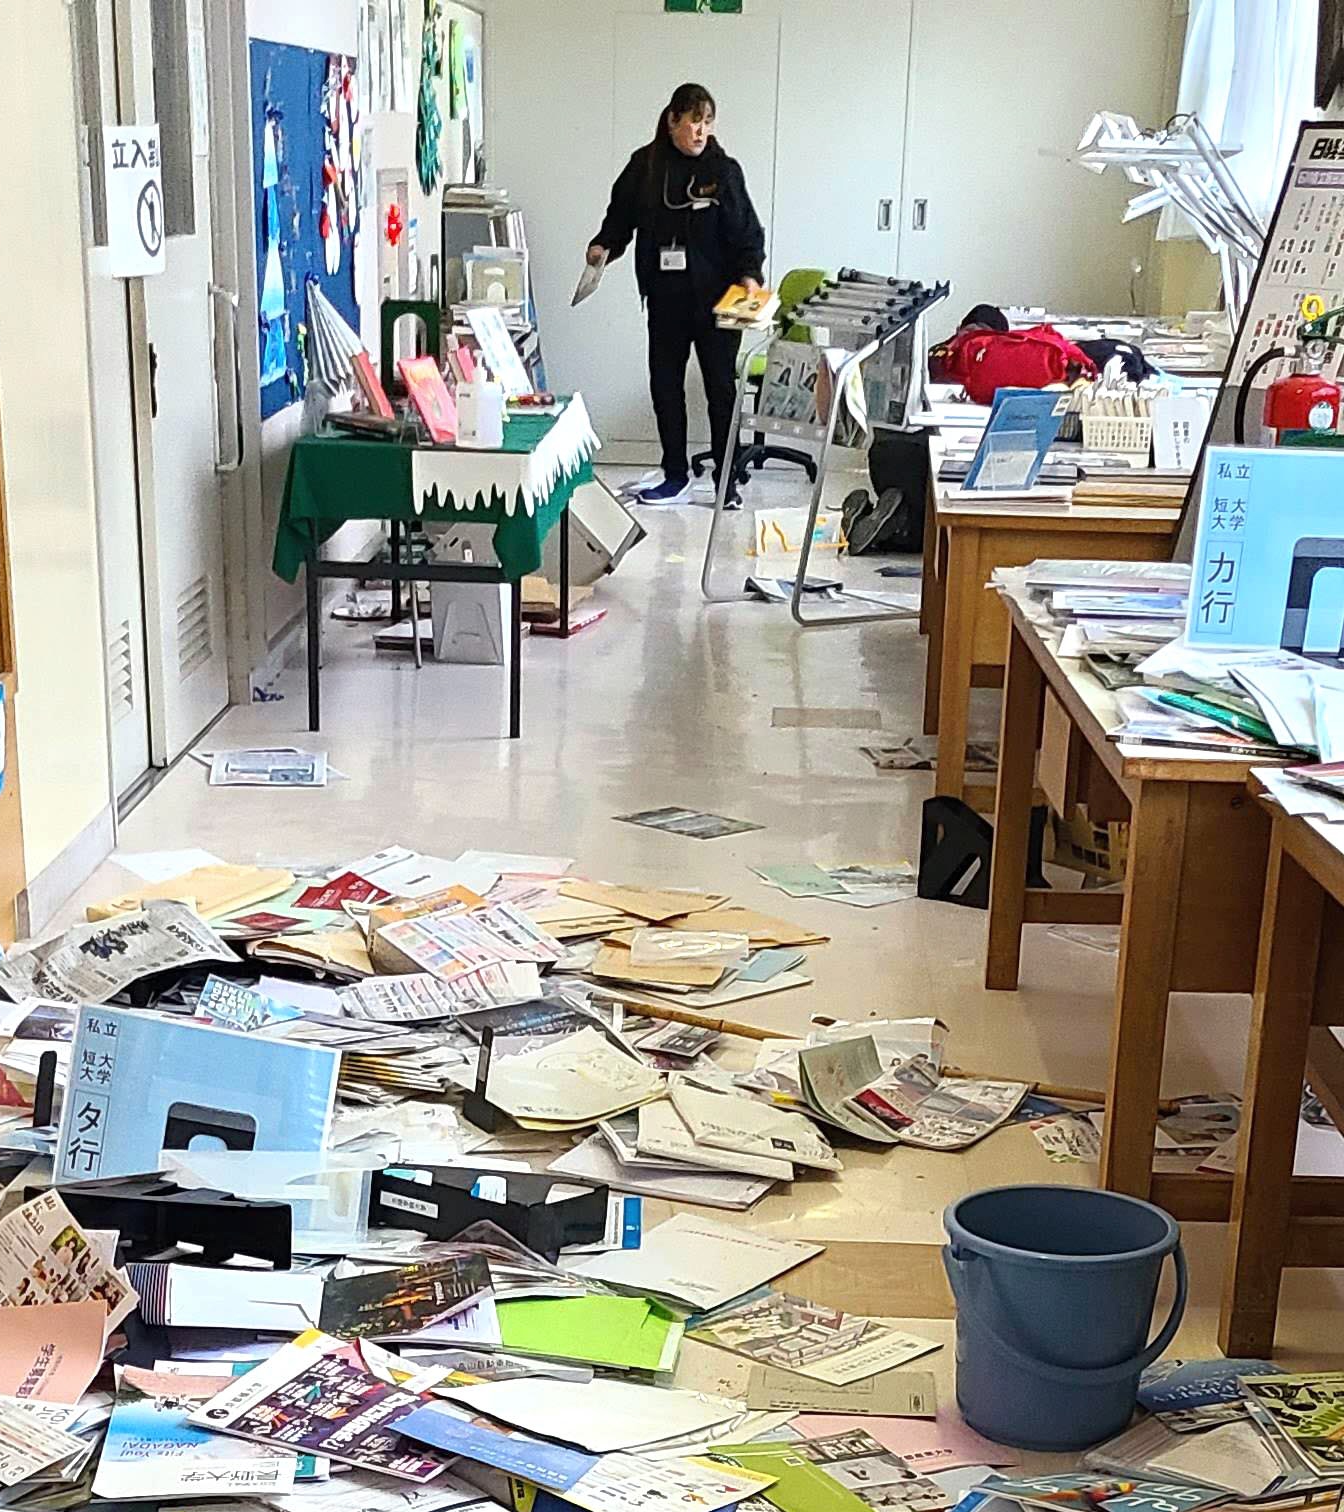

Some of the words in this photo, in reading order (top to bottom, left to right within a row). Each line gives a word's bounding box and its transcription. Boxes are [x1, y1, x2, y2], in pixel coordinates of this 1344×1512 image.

[1217, 463, 1251, 479] 私立
[1201, 551, 1235, 624] カ行
[86, 1018, 117, 1038] 私立
[67, 1101, 102, 1172] タ行
